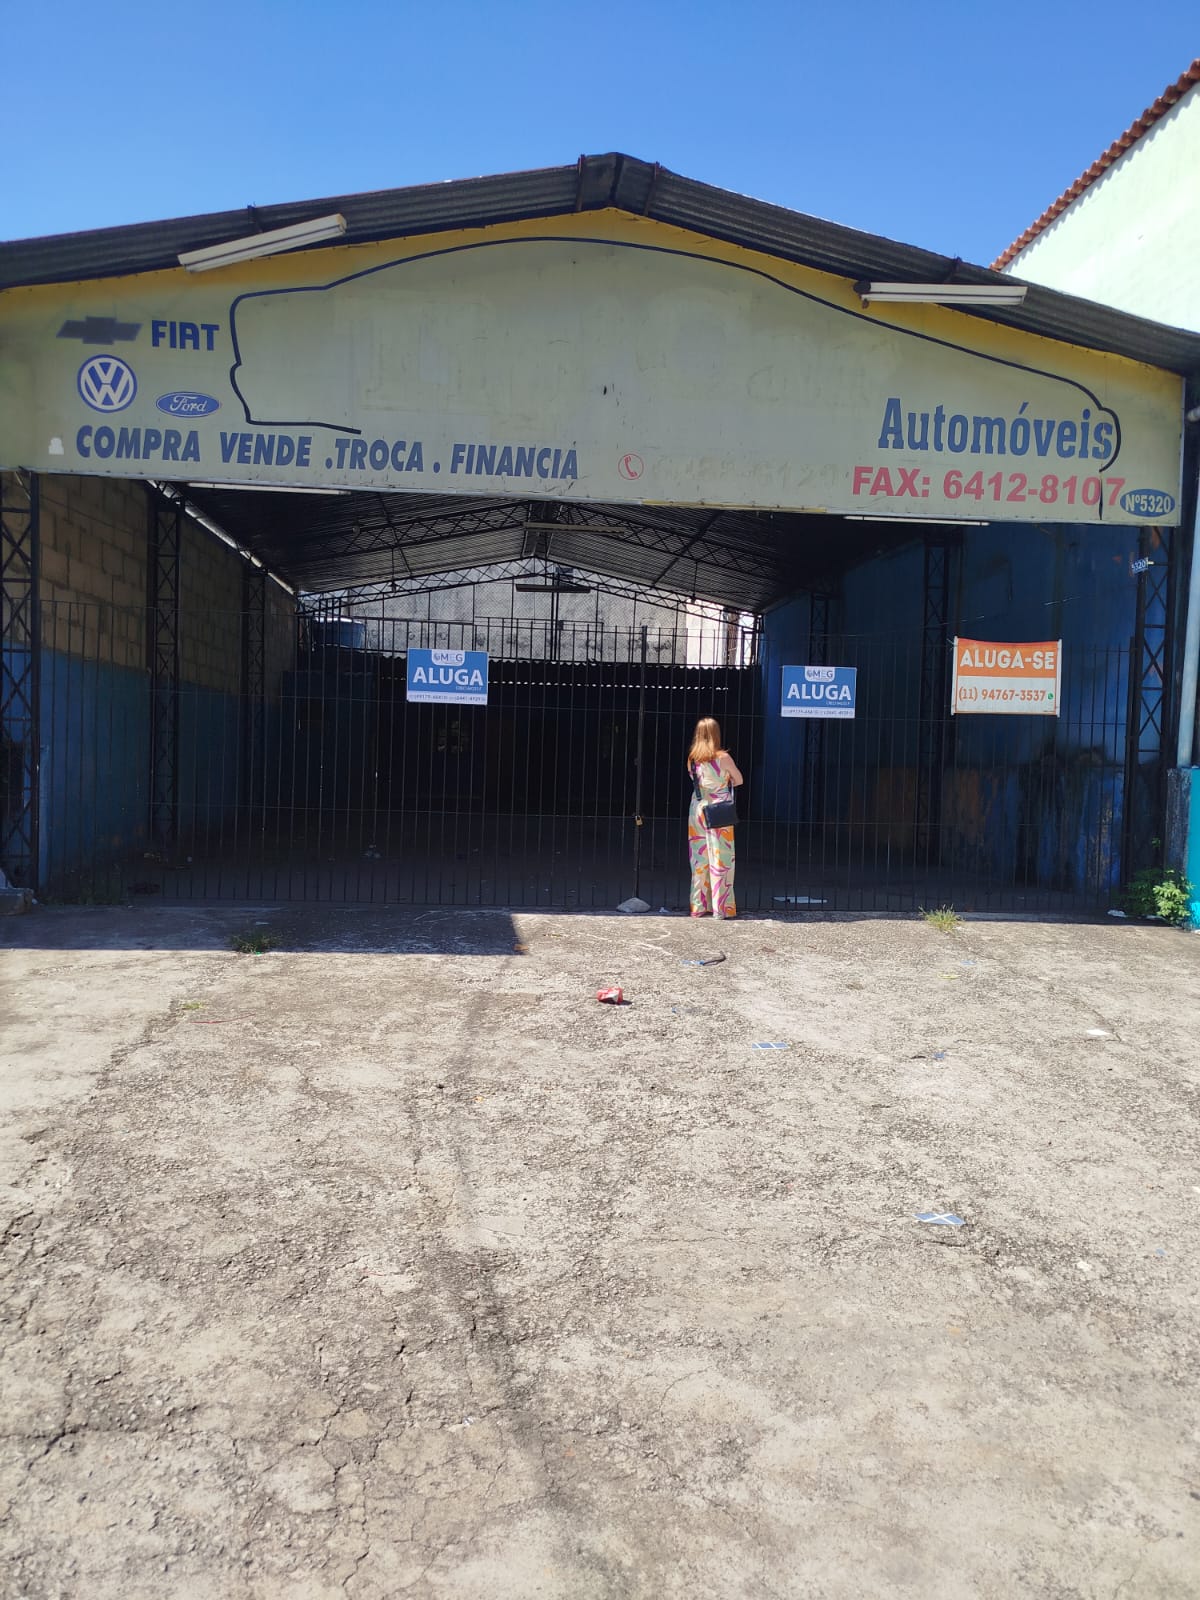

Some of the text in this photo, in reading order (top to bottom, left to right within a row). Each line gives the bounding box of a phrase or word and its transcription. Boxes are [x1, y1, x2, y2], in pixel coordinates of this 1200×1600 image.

[151, 319, 220, 351] FIAT
[170, 395, 208, 412] Ford
[877, 397, 1113, 460] Automóveis
[76, 424, 201, 462] COMPRA
[219, 431, 312, 467] VENDE
[450, 443, 578, 480] FINANCIA
[852, 466, 930, 498] FAX:
[943, 469, 1126, 507] 6412-8107
[959, 649, 1055, 670] ALUGA-SE
[412, 666, 484, 686] ALUGA
[787, 683, 852, 701] ALUGA
[958, 687, 1046, 701] (11) 94767-3537
